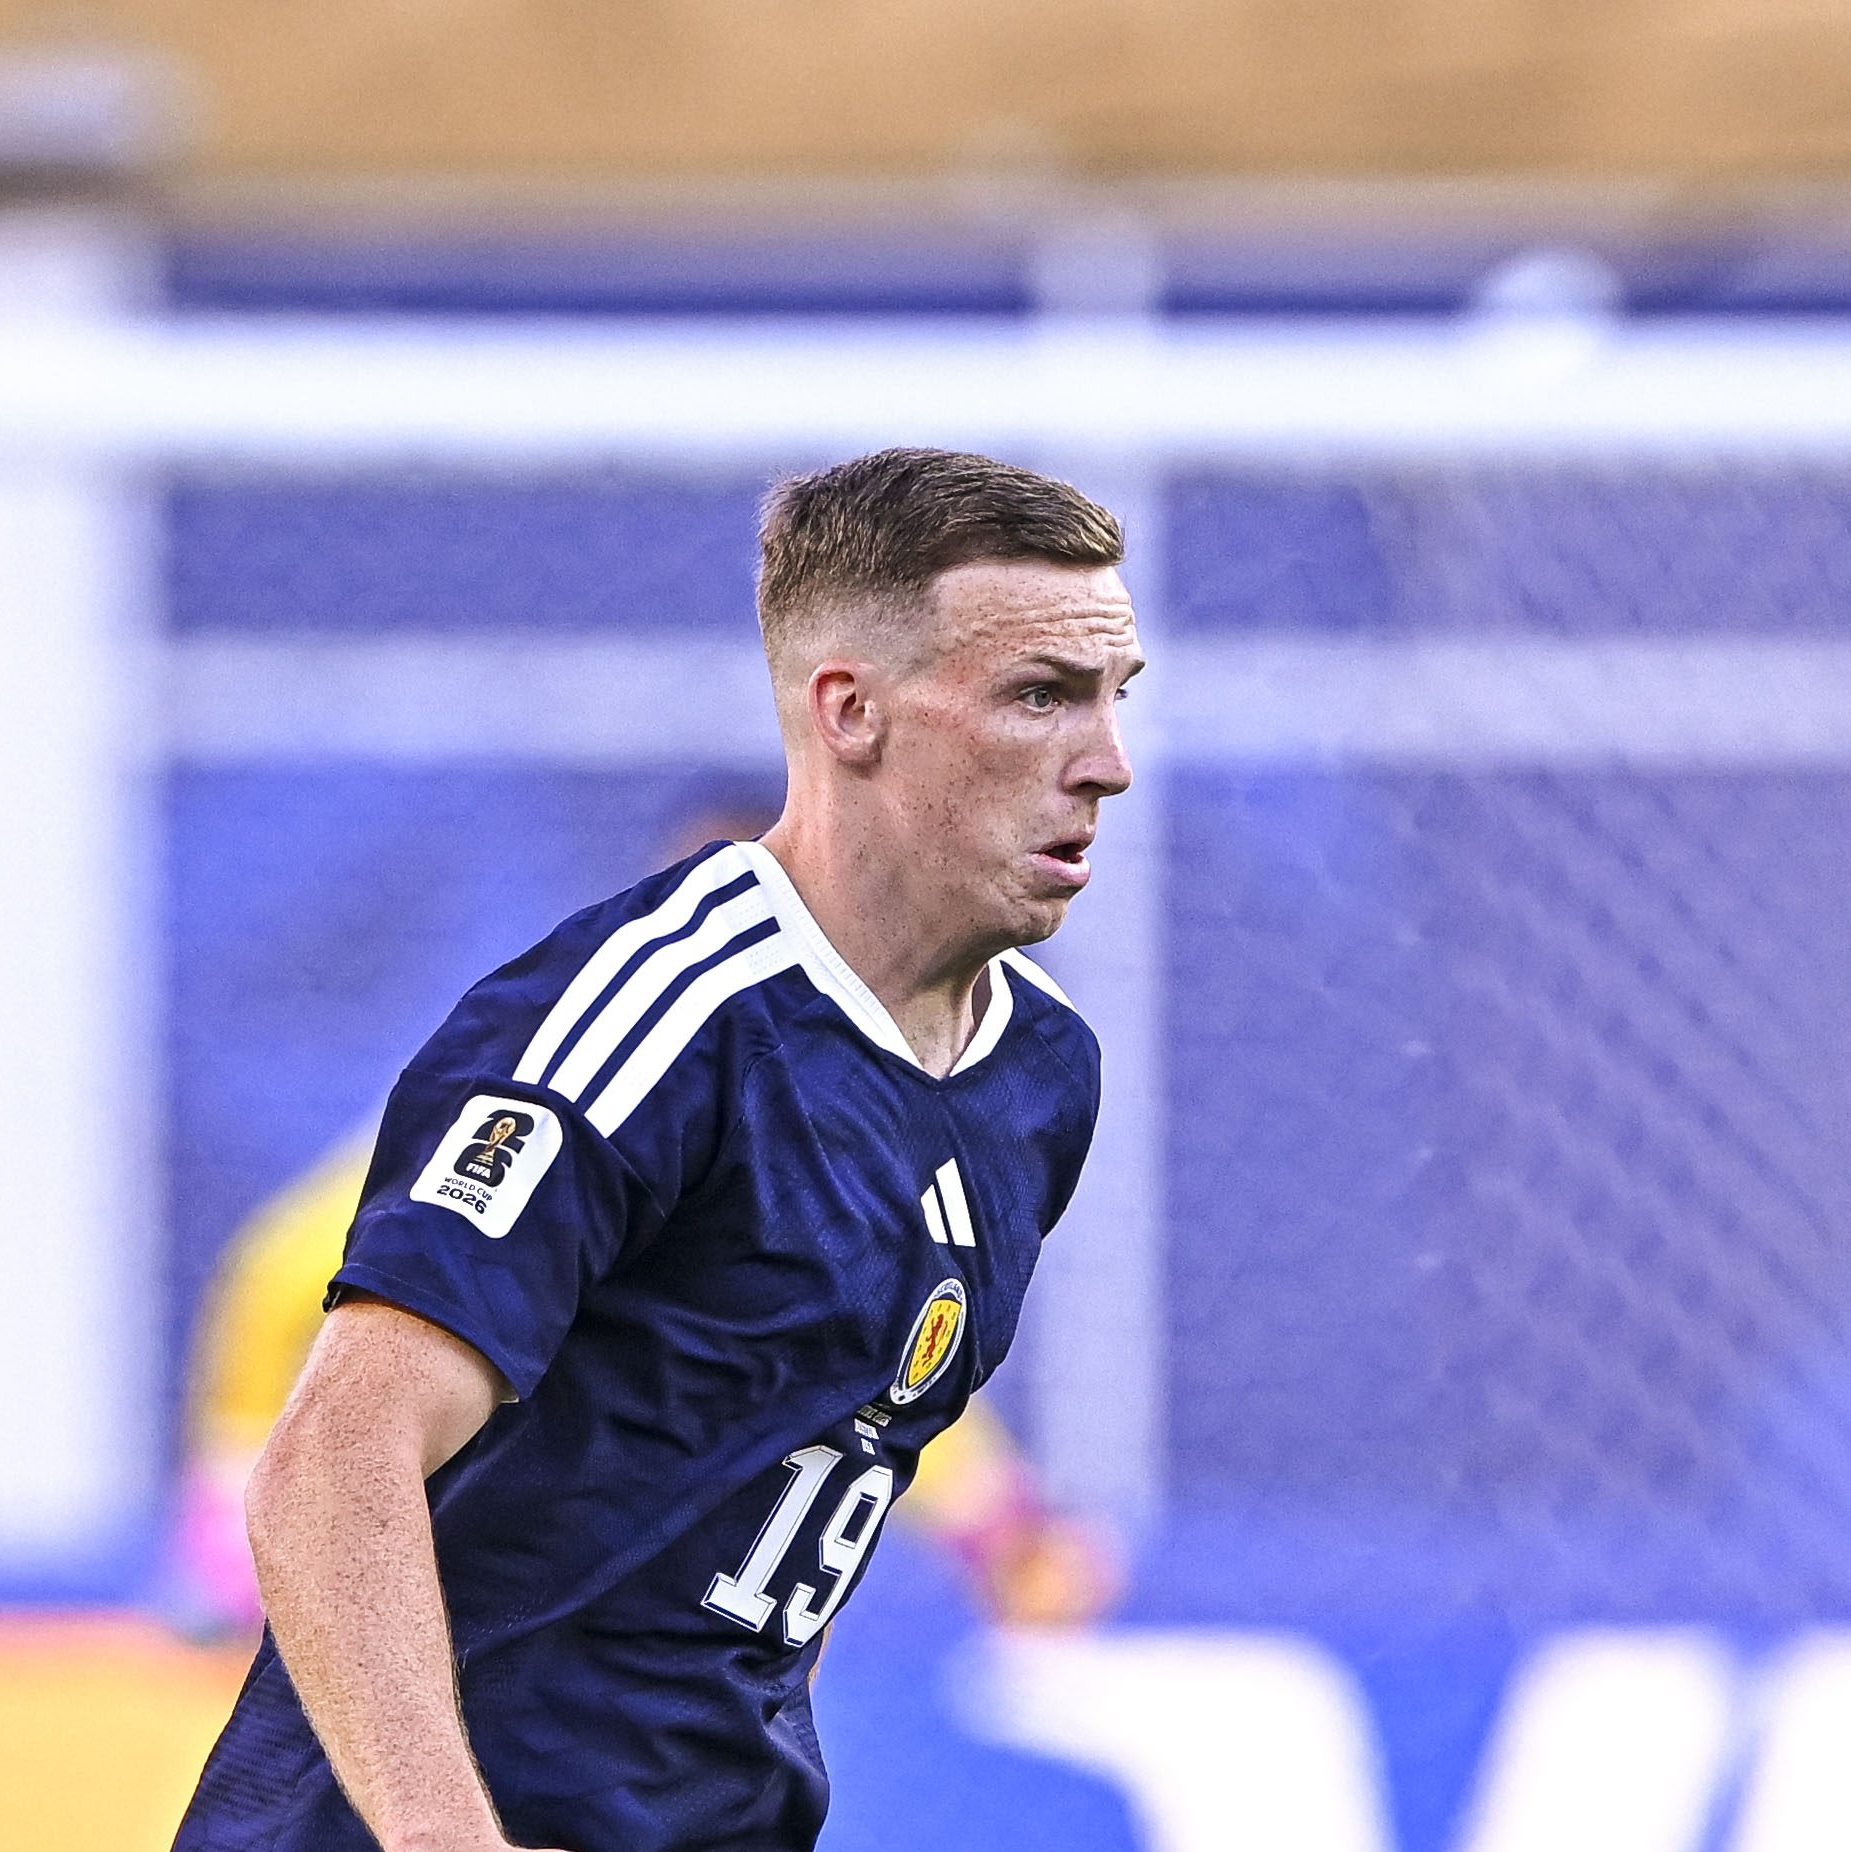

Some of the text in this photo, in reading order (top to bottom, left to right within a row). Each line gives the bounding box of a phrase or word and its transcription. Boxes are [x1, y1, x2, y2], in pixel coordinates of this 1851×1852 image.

[466, 1162, 492, 1179] FIFA
[436, 1184, 488, 1215] 2026
[444, 1177, 493, 1201] WORLD CUP
[700, 1444, 894, 1649] 19
